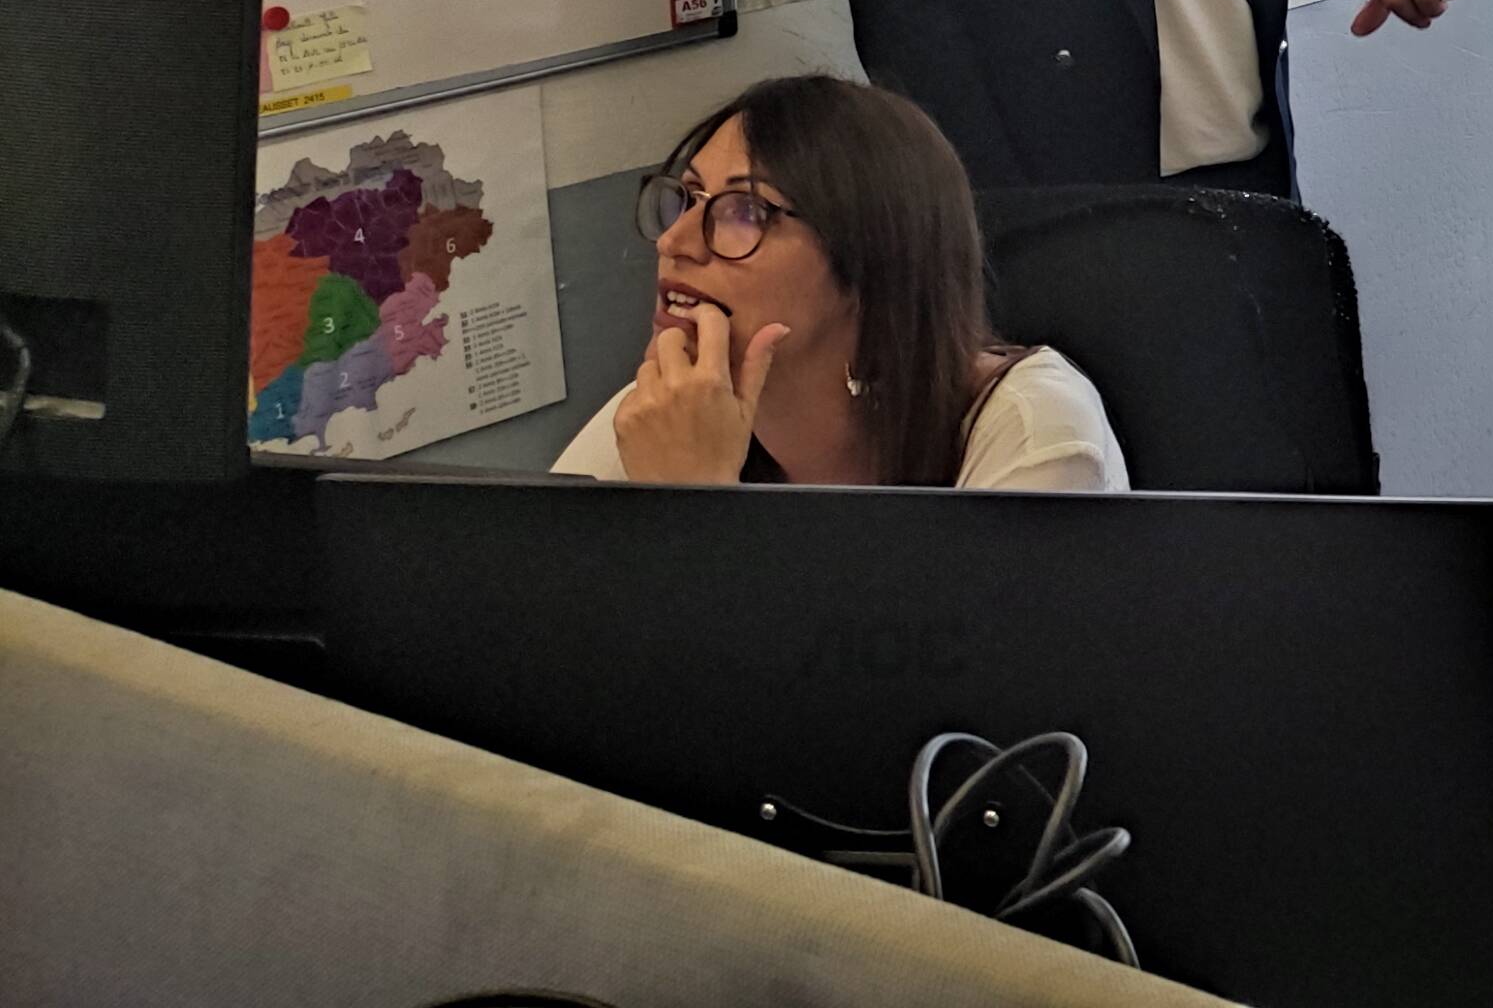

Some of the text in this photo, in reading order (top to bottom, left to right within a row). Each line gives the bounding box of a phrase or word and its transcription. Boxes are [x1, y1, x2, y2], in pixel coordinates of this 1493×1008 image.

[354, 227, 365, 244] 4
[446, 238, 456, 253] 6
[323, 317, 336, 334] 3
[394, 325, 404, 341] 5
[339, 373, 349, 388] 2
[277, 403, 284, 419] 1
